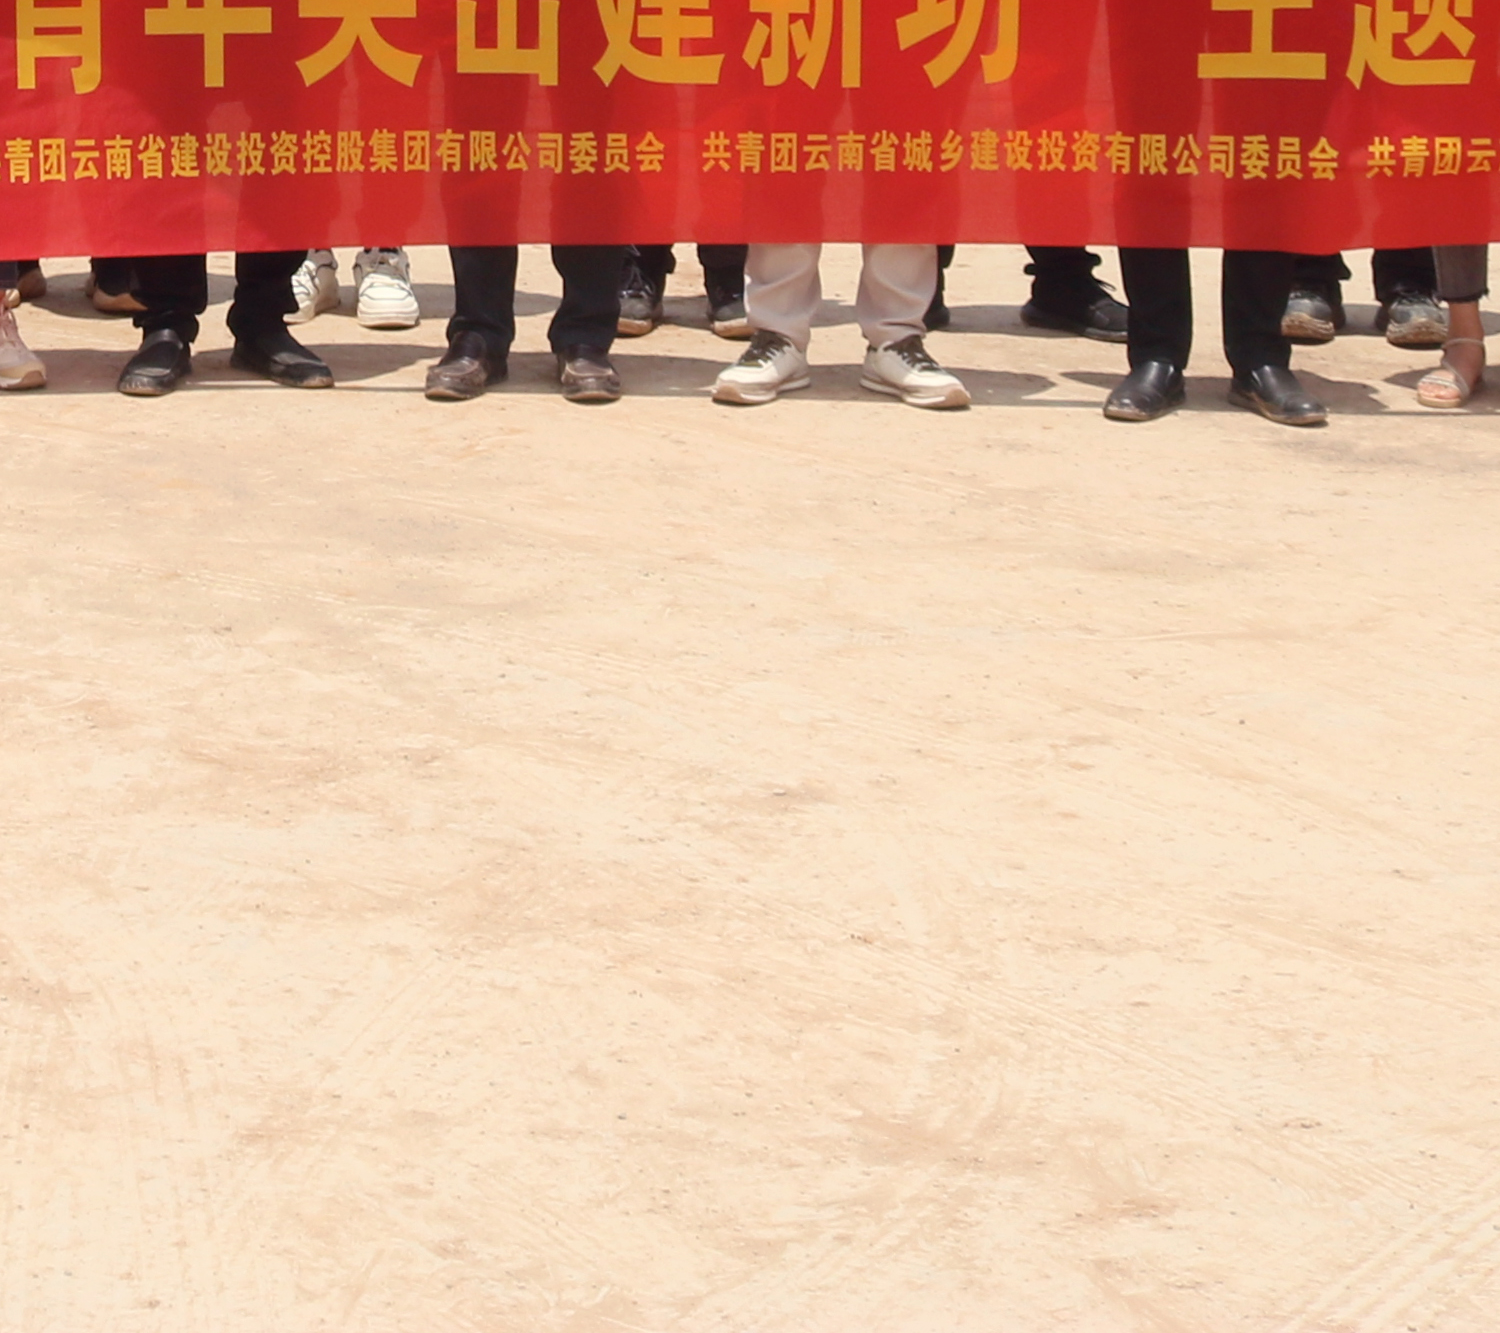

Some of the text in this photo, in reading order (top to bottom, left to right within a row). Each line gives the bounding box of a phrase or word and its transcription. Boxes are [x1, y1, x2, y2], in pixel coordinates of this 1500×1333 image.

[702, 129, 1340, 181] 共青团云南省城乡建设投资有限公司委员会
